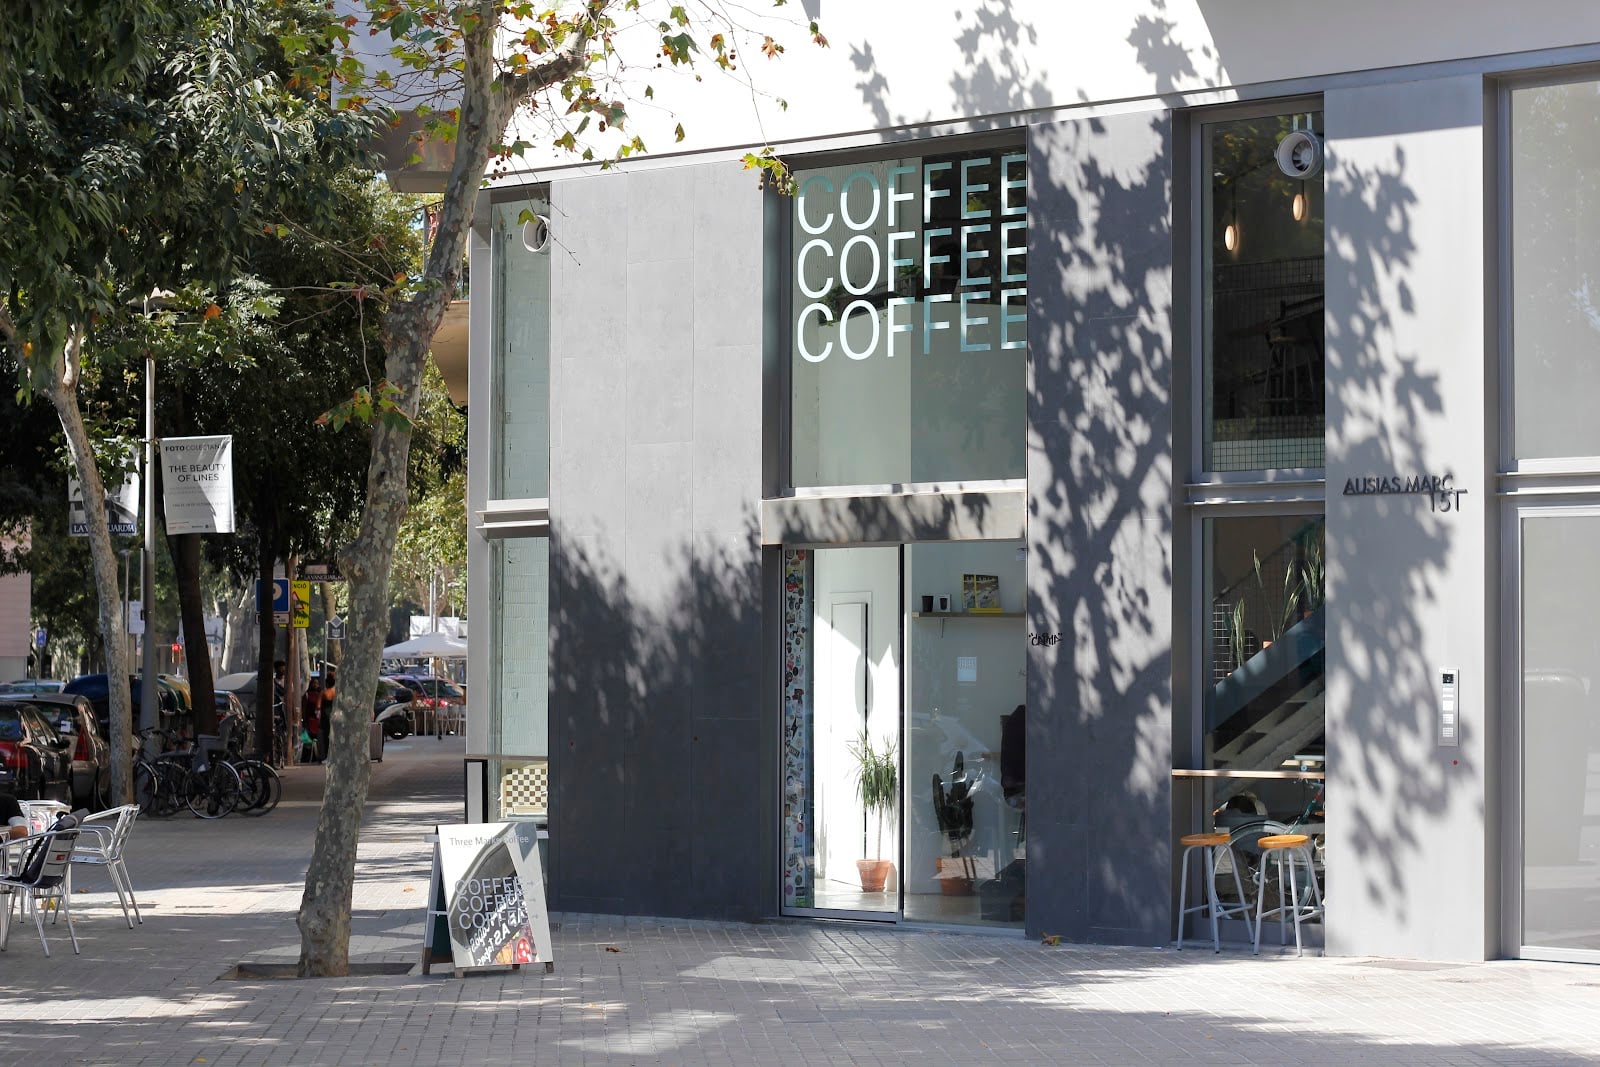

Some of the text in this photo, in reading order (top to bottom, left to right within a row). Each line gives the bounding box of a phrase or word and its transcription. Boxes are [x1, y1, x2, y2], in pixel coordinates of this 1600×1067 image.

[797, 154, 1027, 235] COFFEE
[797, 220, 1027, 299] COFFEE
[797, 287, 1027, 363] COFFEE
[168, 463, 226, 473] THE BEAUTY
[177, 473, 220, 483] OF LINES
[1342, 473, 1454, 495] AUSIAS MARC
[450, 836, 473, 846] Three
[455, 875, 523, 896] COFFEE
